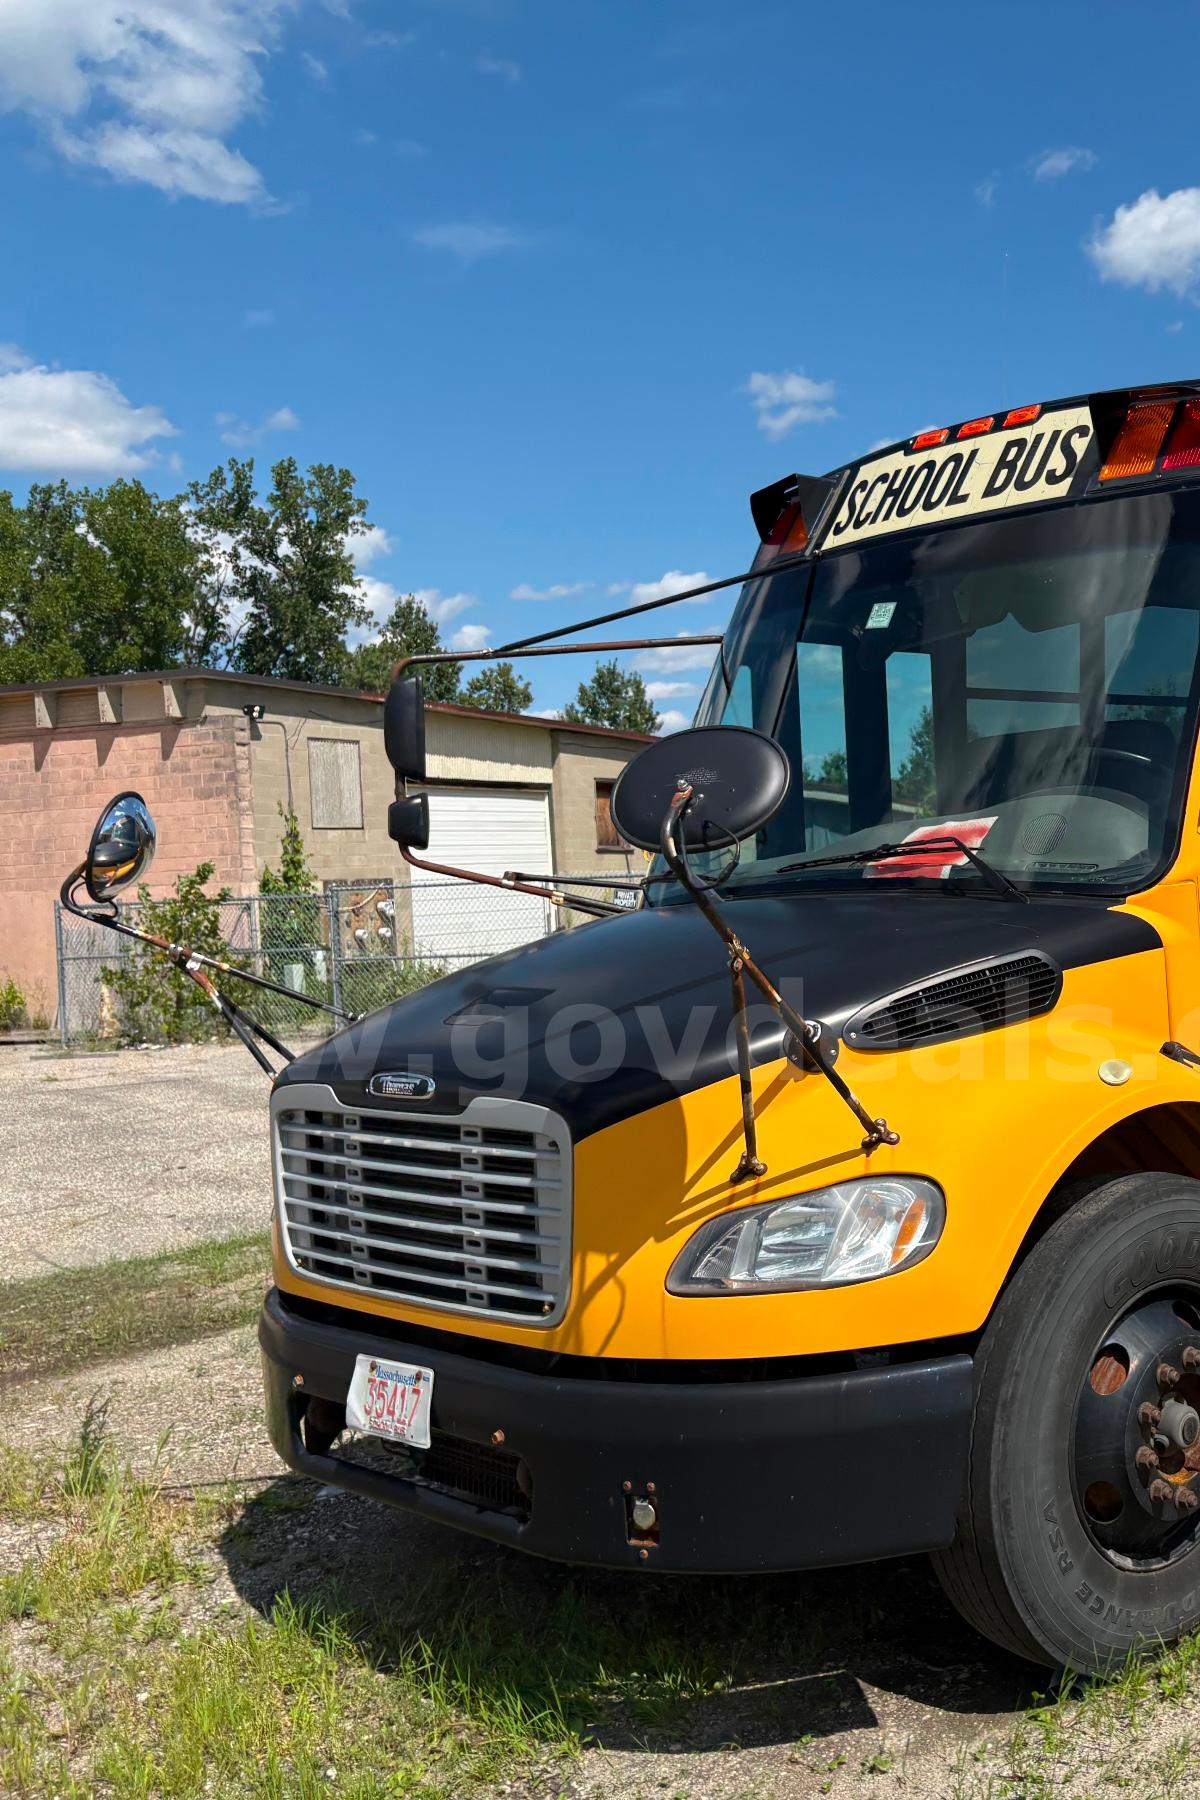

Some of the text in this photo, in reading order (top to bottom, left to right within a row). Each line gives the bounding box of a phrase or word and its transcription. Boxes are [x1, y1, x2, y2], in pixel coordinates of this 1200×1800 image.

[832, 424, 1091, 536] SCHOOL BUS
[363, 1376, 423, 1427] 35417
[1043, 1496, 1075, 1577] RSA
